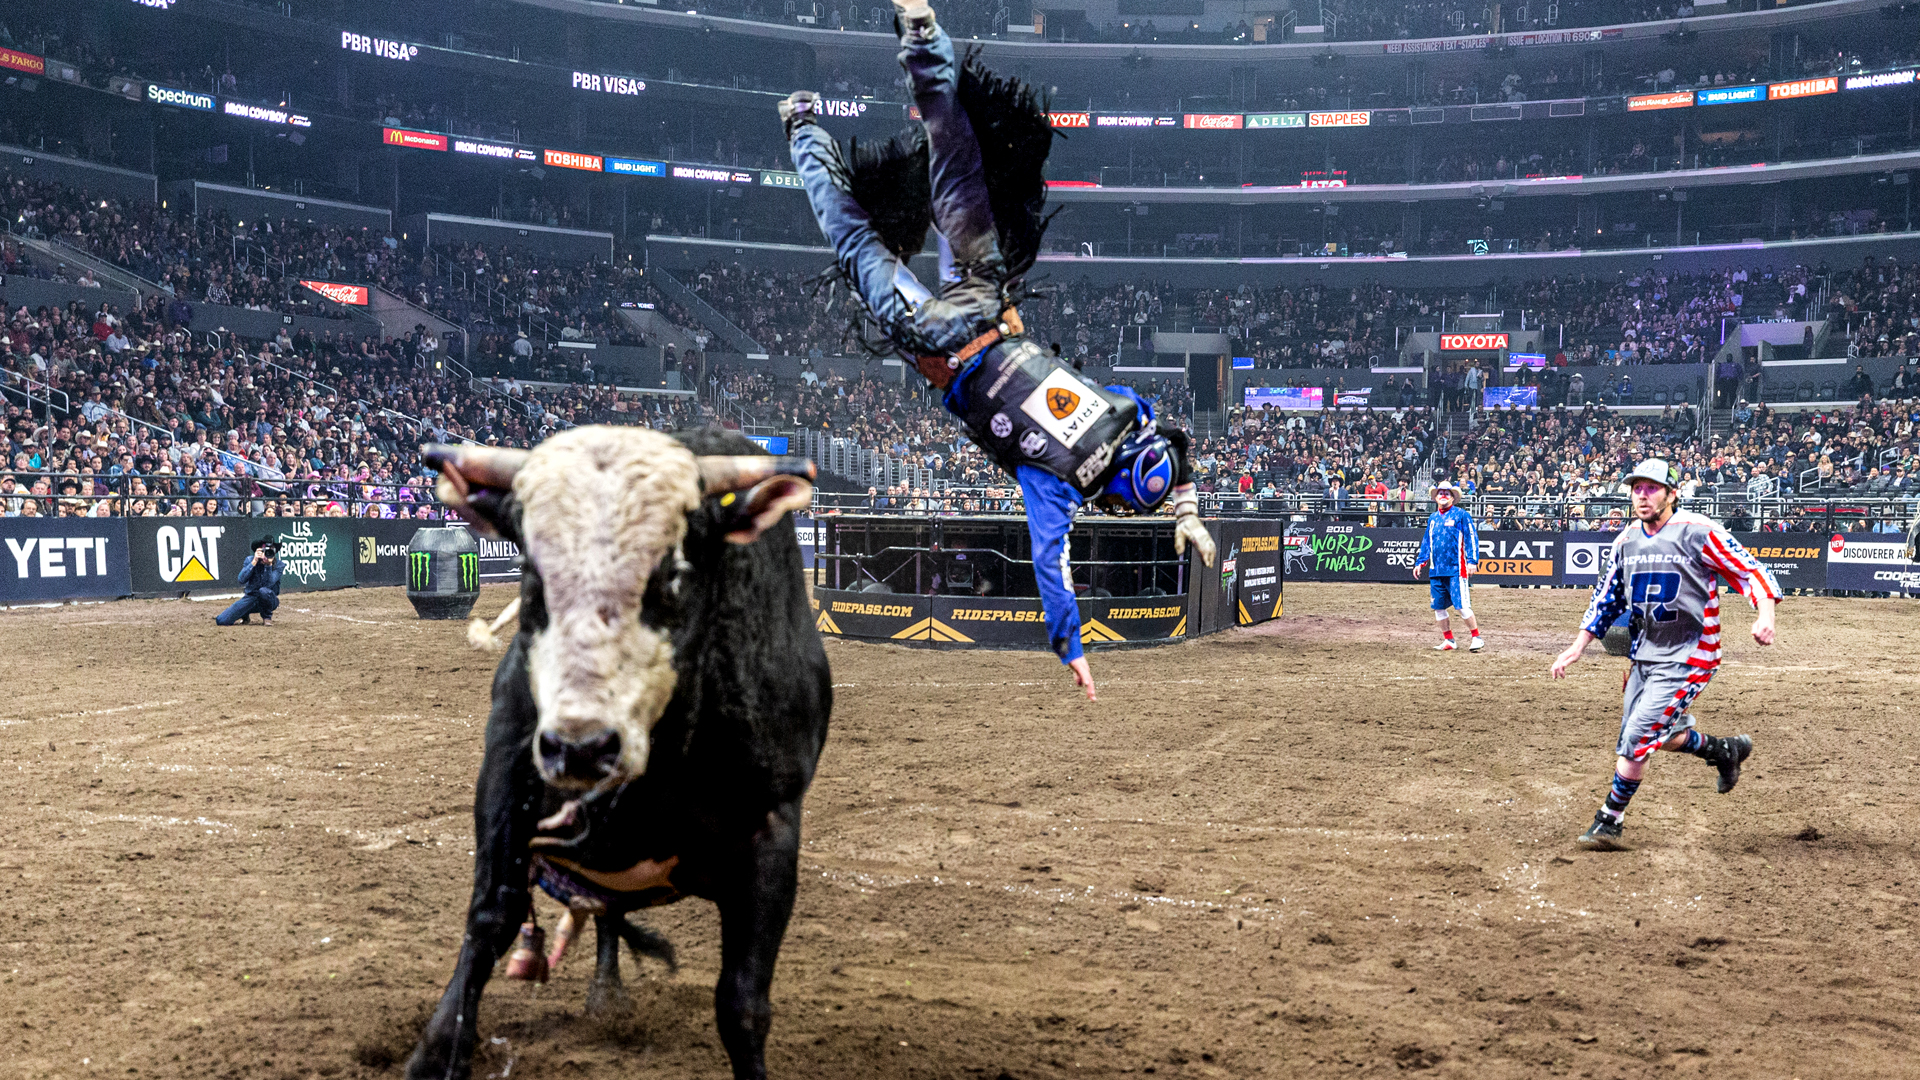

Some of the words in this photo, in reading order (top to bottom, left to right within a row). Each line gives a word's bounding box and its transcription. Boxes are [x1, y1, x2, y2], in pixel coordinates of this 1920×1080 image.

[342, 31, 371, 54] PBR
[1387, 44, 1402, 53] NEED
[1403, 42, 1441, 53] ASSISTANCE?
[1443, 41, 1457, 50] TEXT
[1507, 36, 1524, 46] ISSUE
[1535, 33, 1562, 44] LOCATION
[1563, 34, 1571, 42] TO
[12, 56, 43, 70] FARGO
[572, 72, 601, 92] PBR
[1771, 79, 1836, 98] TOSHIBA
[149, 84, 212, 109] Spectrum
[1708, 93, 1726, 101] BUD
[1728, 89, 1756, 100] LIGHT
[225, 101, 249, 117] IRON
[249, 107, 288, 124] COWBOY
[1049, 114, 1089, 126] YOTA
[1310, 112, 1368, 126] STAPLES
[1097, 116, 1118, 126] IRON
[1118, 116, 1153, 127] COWBOY
[1262, 116, 1303, 126] DELTA
[455, 141, 477, 153] IRON
[477, 144, 514, 159] COWBOY
[545, 151, 601, 170] TOSHIBA
[613, 162, 632, 172] BUD
[632, 164, 658, 174] LIGHT
[673, 167, 695, 179] IRON
[695, 169, 730, 182] COWBOY
[1441, 335, 1508, 349] TOYOTA
[1062, 399, 1100, 442] ARIAT
[292, 521, 313, 537] U.S.
[1326, 525, 1354, 533] 2019
[280, 541, 327, 557] BORDER
[376, 544, 398, 557] MGM
[1311, 533, 1373, 554] WORLD
[1382, 540, 1420, 548] TICKETS
[1831, 539, 1845, 548] NEW
[4, 537, 107, 579] YETI
[156, 525, 221, 583] CAT
[1843, 547, 1895, 559] DISCOVERER
[282, 559, 326, 575] PATROL
[1312, 551, 1366, 572] FINALS
[831, 601, 914, 618] RIDEPASS.COM
[1107, 605, 1182, 619] RIDEPASS.COM
